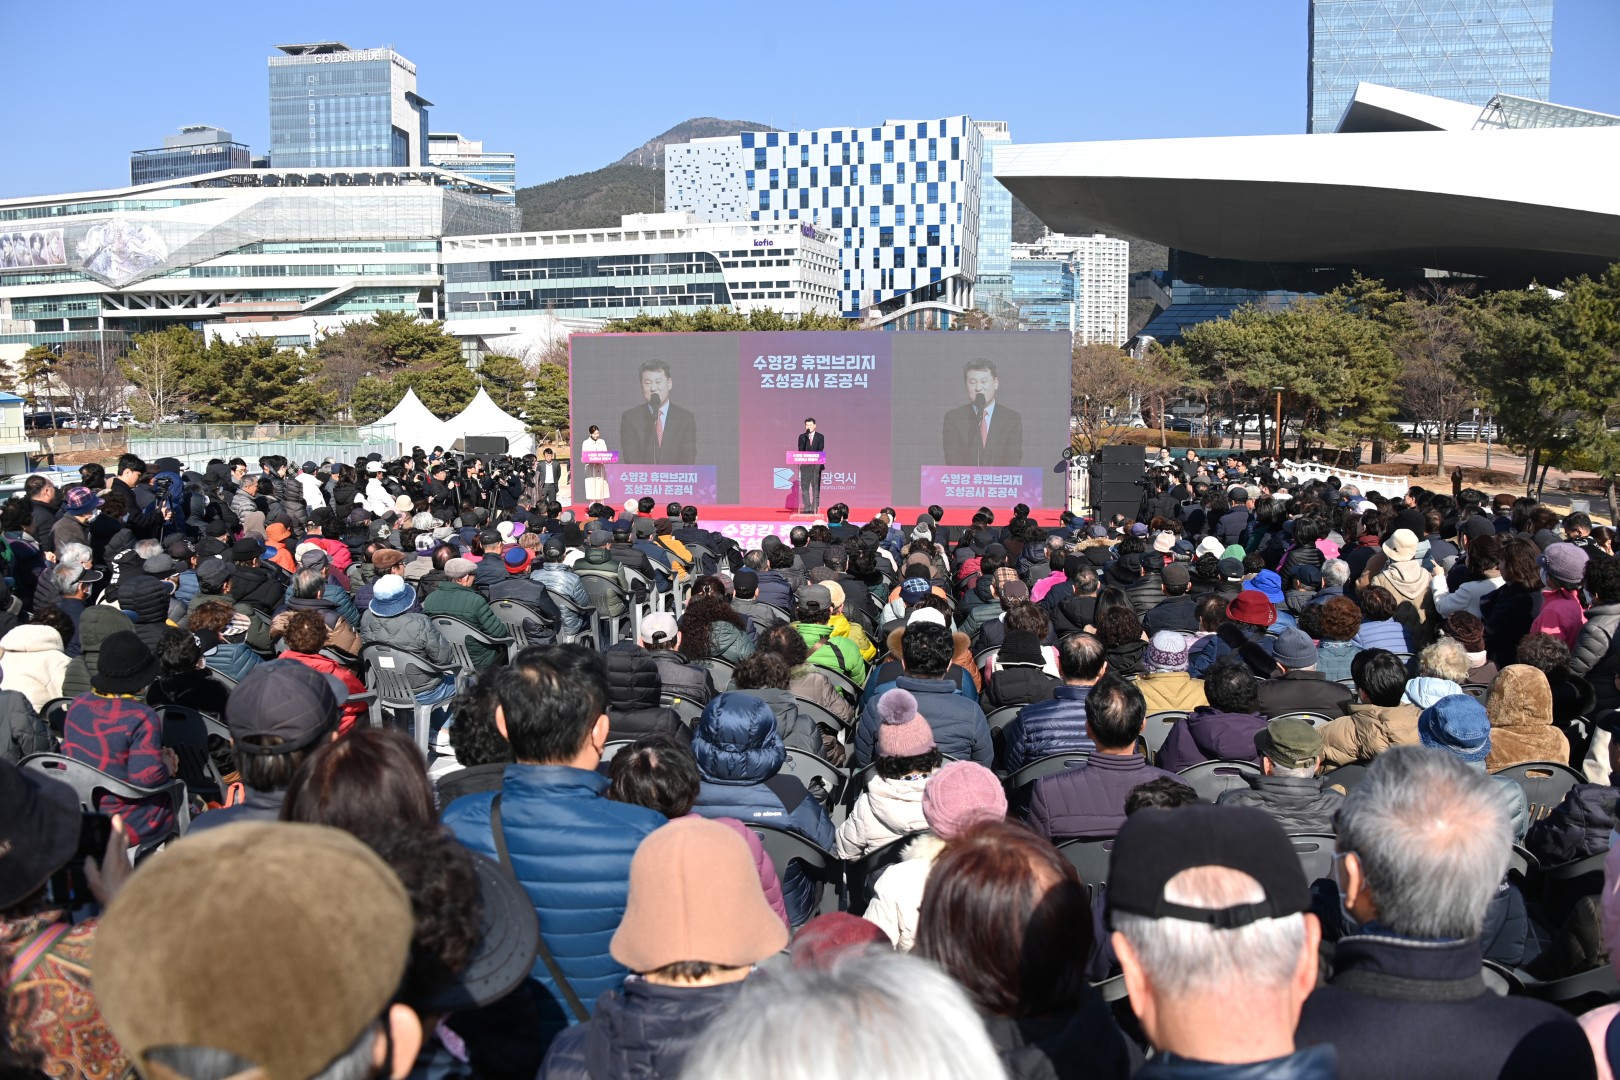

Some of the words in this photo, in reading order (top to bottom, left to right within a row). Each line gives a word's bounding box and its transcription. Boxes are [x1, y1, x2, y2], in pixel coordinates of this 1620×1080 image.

[315, 52, 355, 64] GOLDEN
[357, 50, 381, 62] BLUE
[753, 355, 797, 370] 수영강
[801, 354, 876, 370] 휴먼브리지
[760, 373, 820, 388] 조성공사
[823, 373, 868, 388] 준공식
[620, 472, 648, 482] 수영강
[650, 472, 698, 483] 휴먼브리지
[941, 473, 971, 484] 수영강
[973, 474, 1023, 485] 휴먼브리지
[624, 484, 662, 495] 조성공사
[664, 484, 693, 495] 준공식
[945, 486, 985, 497] 조성공사
[987, 487, 1018, 498] 준공식
[722, 524, 774, 537] 수영강
